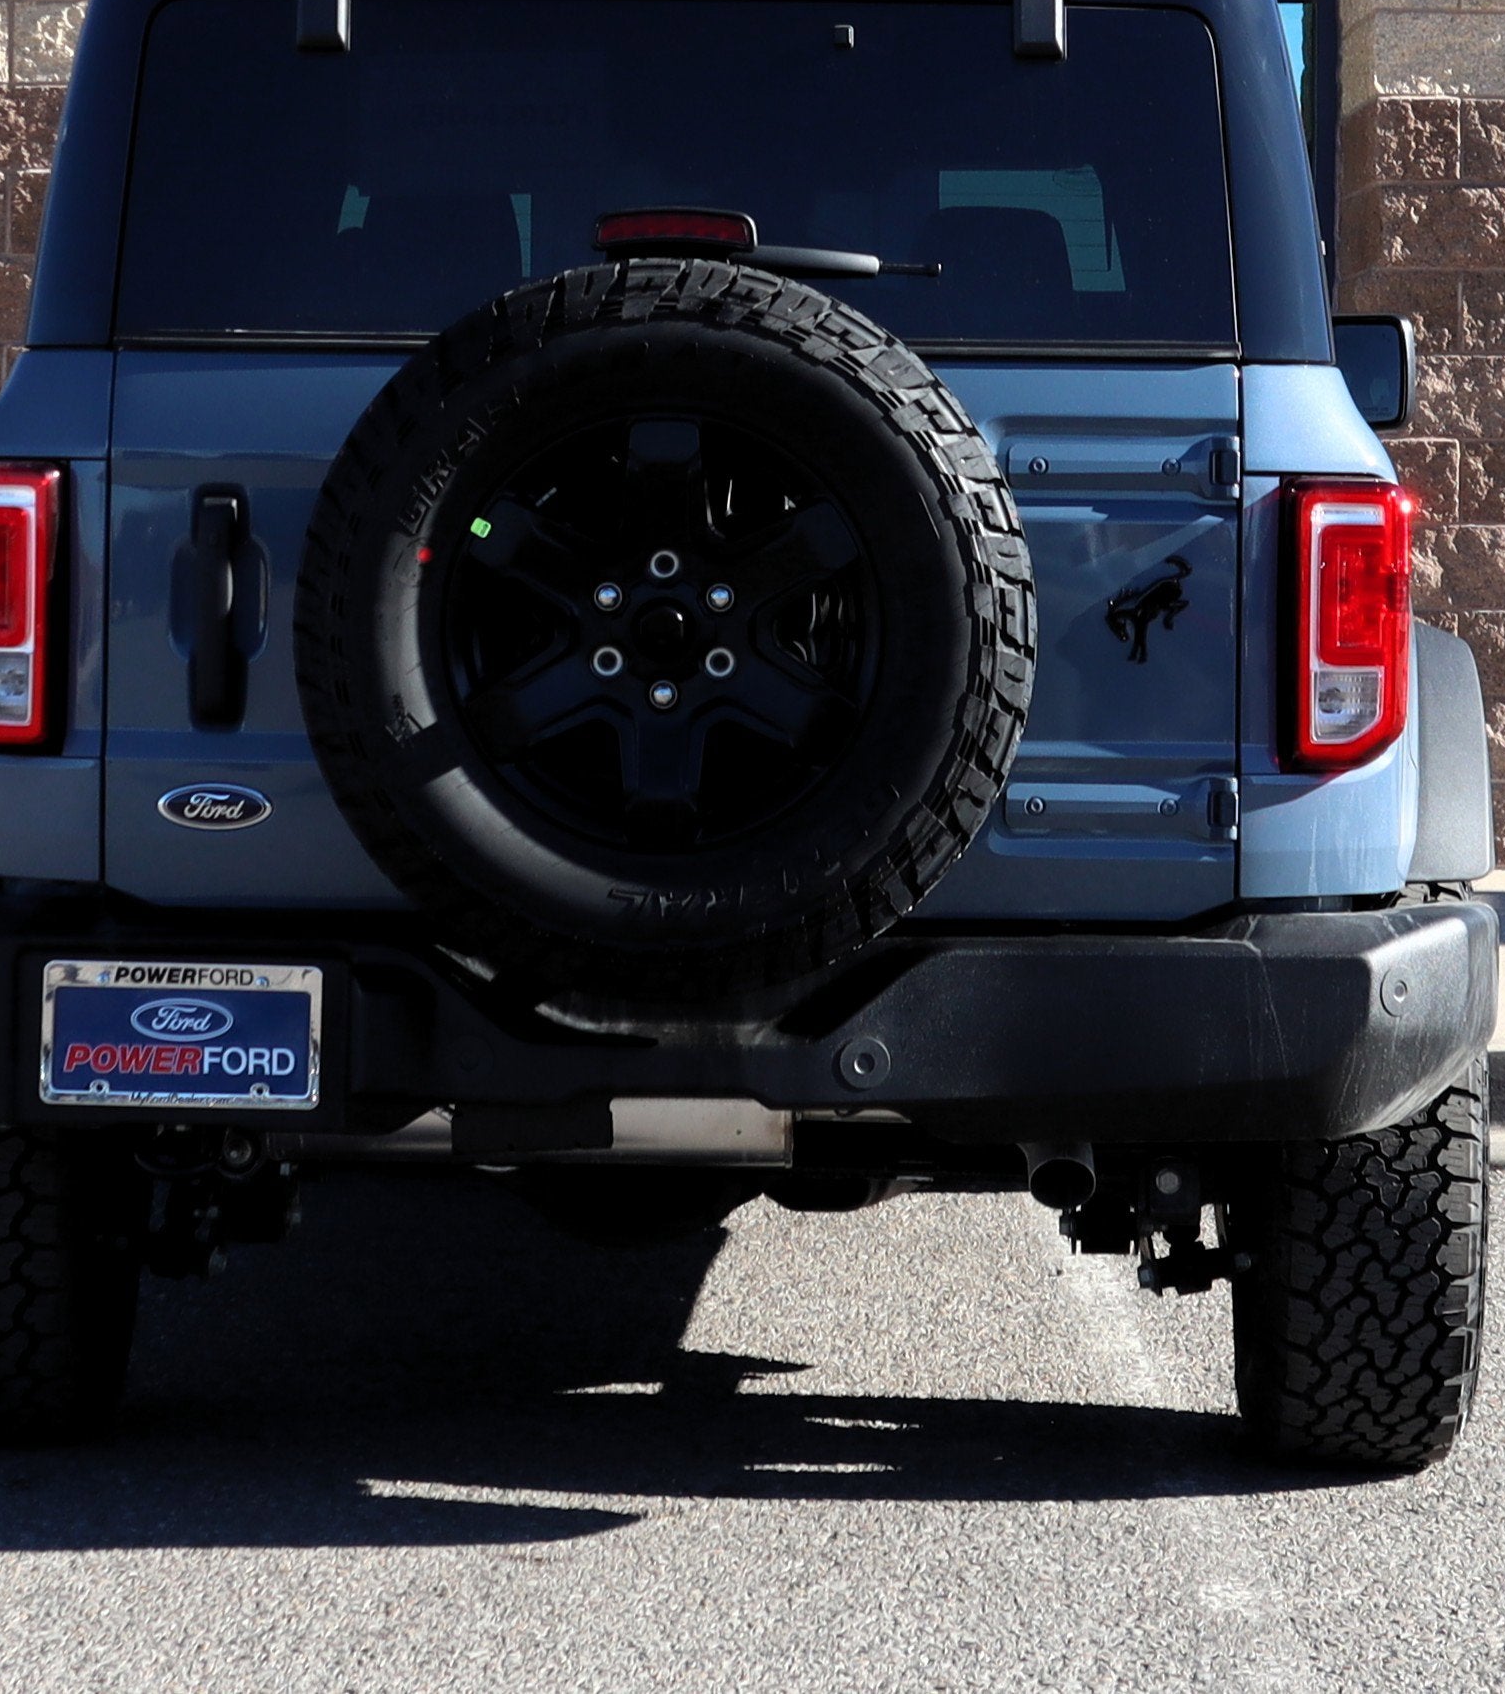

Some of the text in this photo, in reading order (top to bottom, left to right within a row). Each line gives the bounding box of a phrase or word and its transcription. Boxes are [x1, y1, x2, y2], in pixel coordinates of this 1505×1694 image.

[183, 792, 245, 819] Ford
[113, 966, 255, 986] POWERFORD
[151, 1006, 213, 1032] Ford
[63, 1043, 295, 1076] POWERFORD
